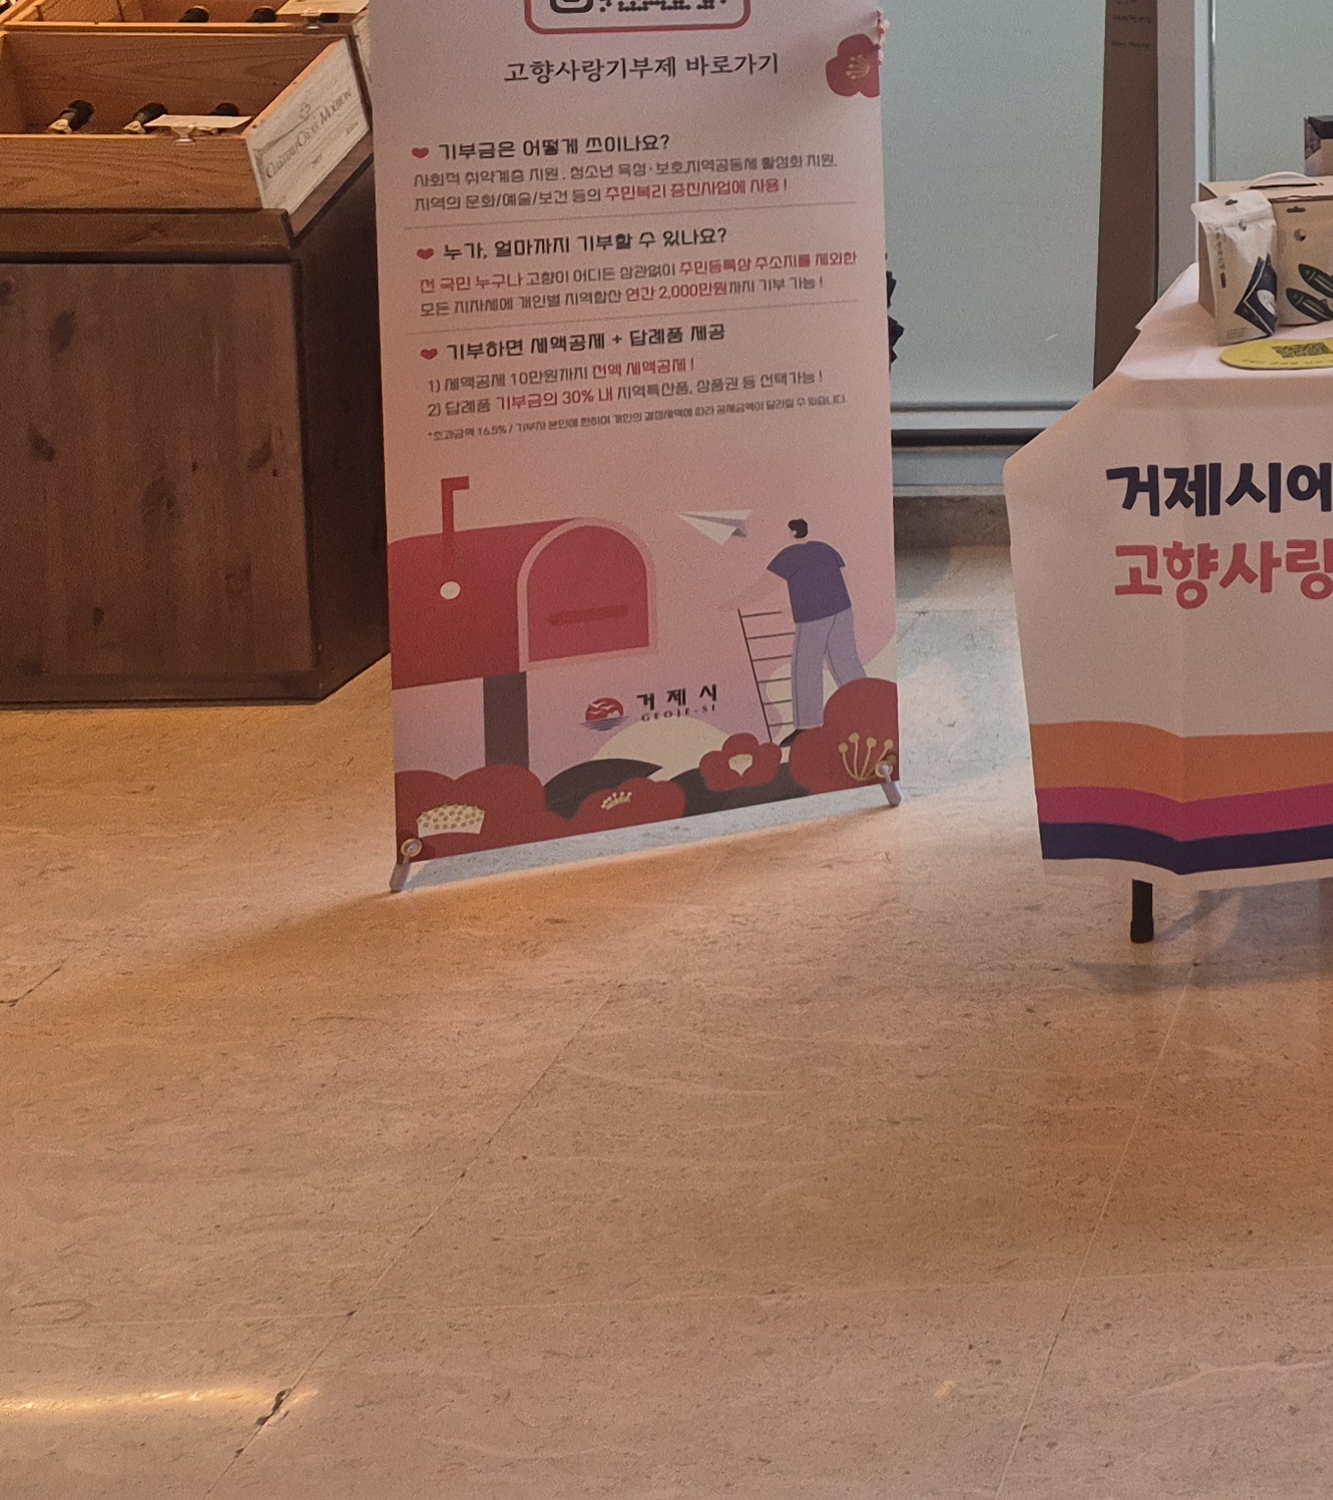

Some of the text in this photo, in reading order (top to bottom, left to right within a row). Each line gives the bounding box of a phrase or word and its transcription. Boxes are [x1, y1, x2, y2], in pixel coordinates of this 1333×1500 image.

[504, 52, 779, 84] 고향사랑기부제 바로가기
[438, 134, 670, 160] 기부금은 어떻게 쓰이나요?
[414, 171, 460, 187] 사회적
[465, 169, 525, 185] 취약계층
[570, 163, 614, 180] 청소년
[762, 155, 803, 170] 활성화
[415, 195, 461, 212] 지역의
[572, 188, 601, 204] 등의
[605, 184, 667, 202] 주민복리
[671, 180, 746, 198] 증진사업에
[443, 227, 727, 261] 누가, 얼마까지 기부할 수 있나요?
[420, 251, 857, 294] 전 국민 누구나 고향이 어디든 상관없이 주민등록상 주소지를 제외한
[420, 302, 450, 318] 모든
[454, 297, 513, 314] 지자체에
[517, 293, 561, 310] 개인별
[565, 290, 621, 307] 지역합산
[625, 286, 655, 302] 연간
[759, 278, 785, 293] 기부
[446, 323, 726, 361] 기부하면 세액공제 + 답례품 제공
[428, 379, 441, 393] 1)
[444, 374, 505, 392] 세액공제
[511, 367, 588, 386] 10만원까지
[592, 363, 622, 380] 전액
[427, 403, 441, 417] 2)
[445, 398, 491, 416] 답례품
[495, 391, 557, 411] 기부금의
[562, 389, 595, 405] 30%
[598, 386, 613, 403] 내
[697, 376, 738, 393] 상품권
[742, 375, 756, 390] 등
